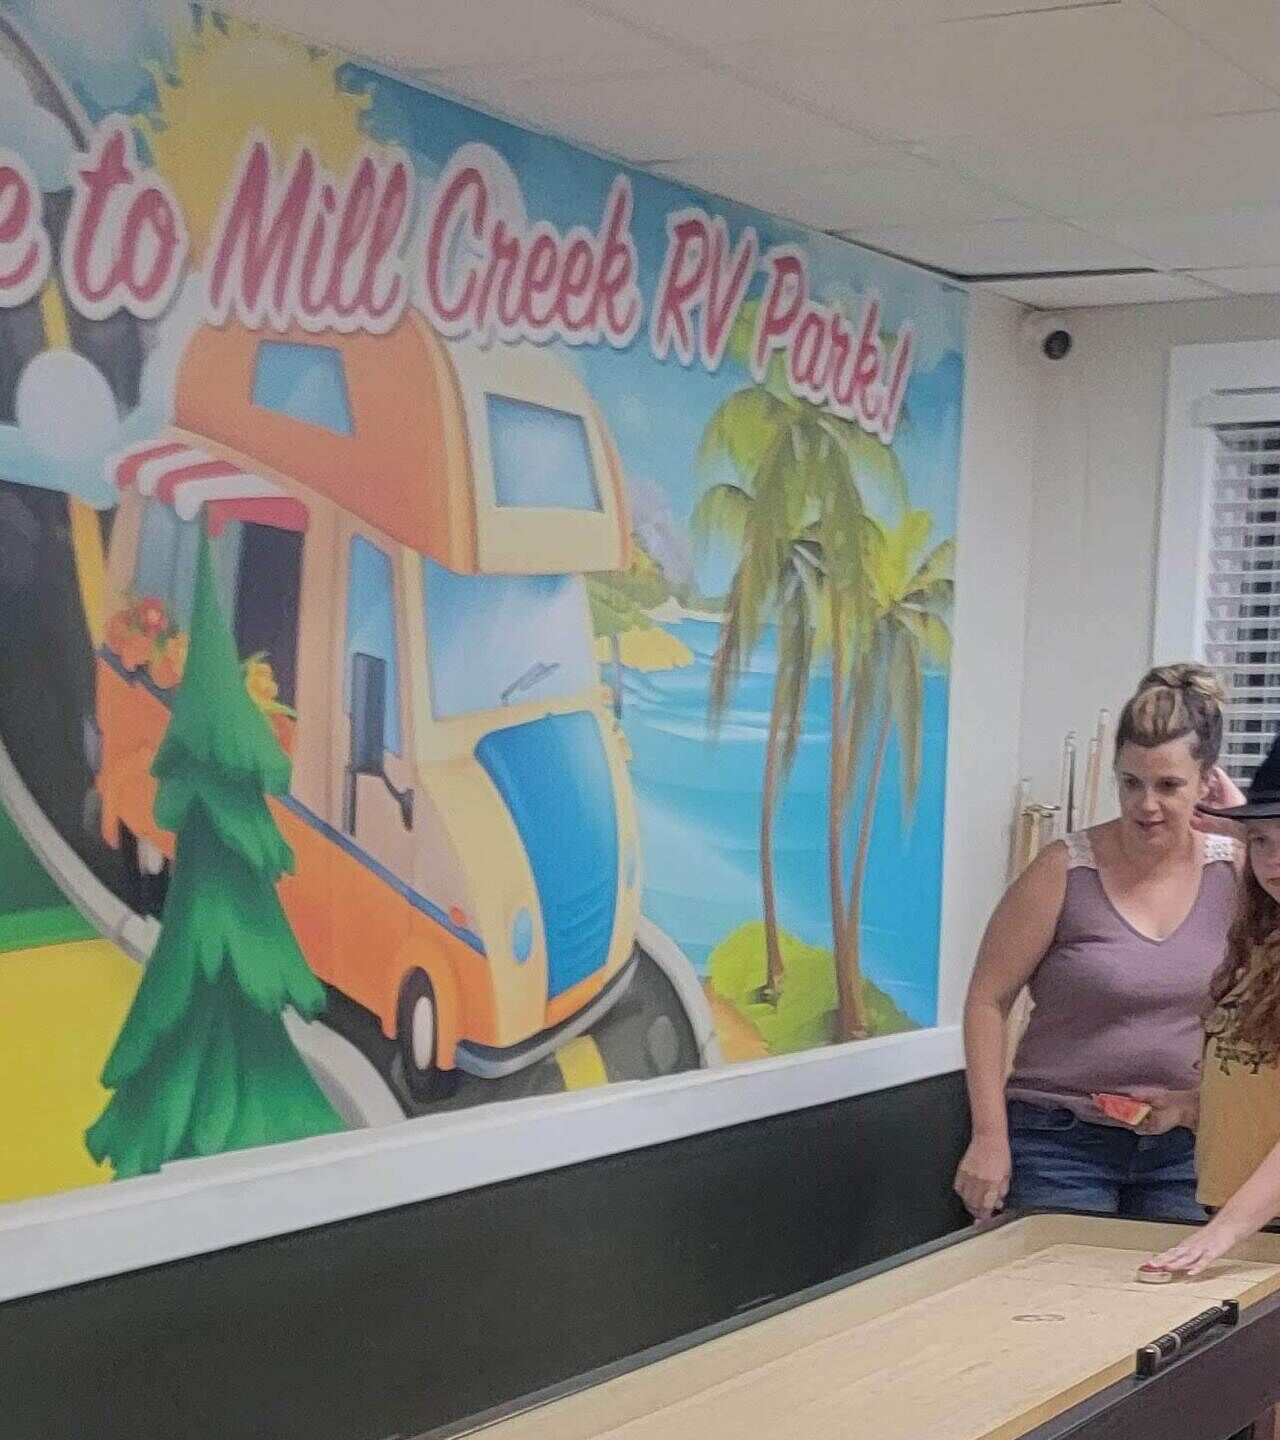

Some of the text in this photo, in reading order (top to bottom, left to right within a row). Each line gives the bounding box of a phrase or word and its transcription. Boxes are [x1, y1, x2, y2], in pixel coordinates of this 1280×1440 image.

[78, 130, 173, 301] to
[209, 142, 410, 315] Mill
[425, 167, 640, 342] Creek
[657, 218, 756, 357] RV
[756, 256, 914, 437] Park!
